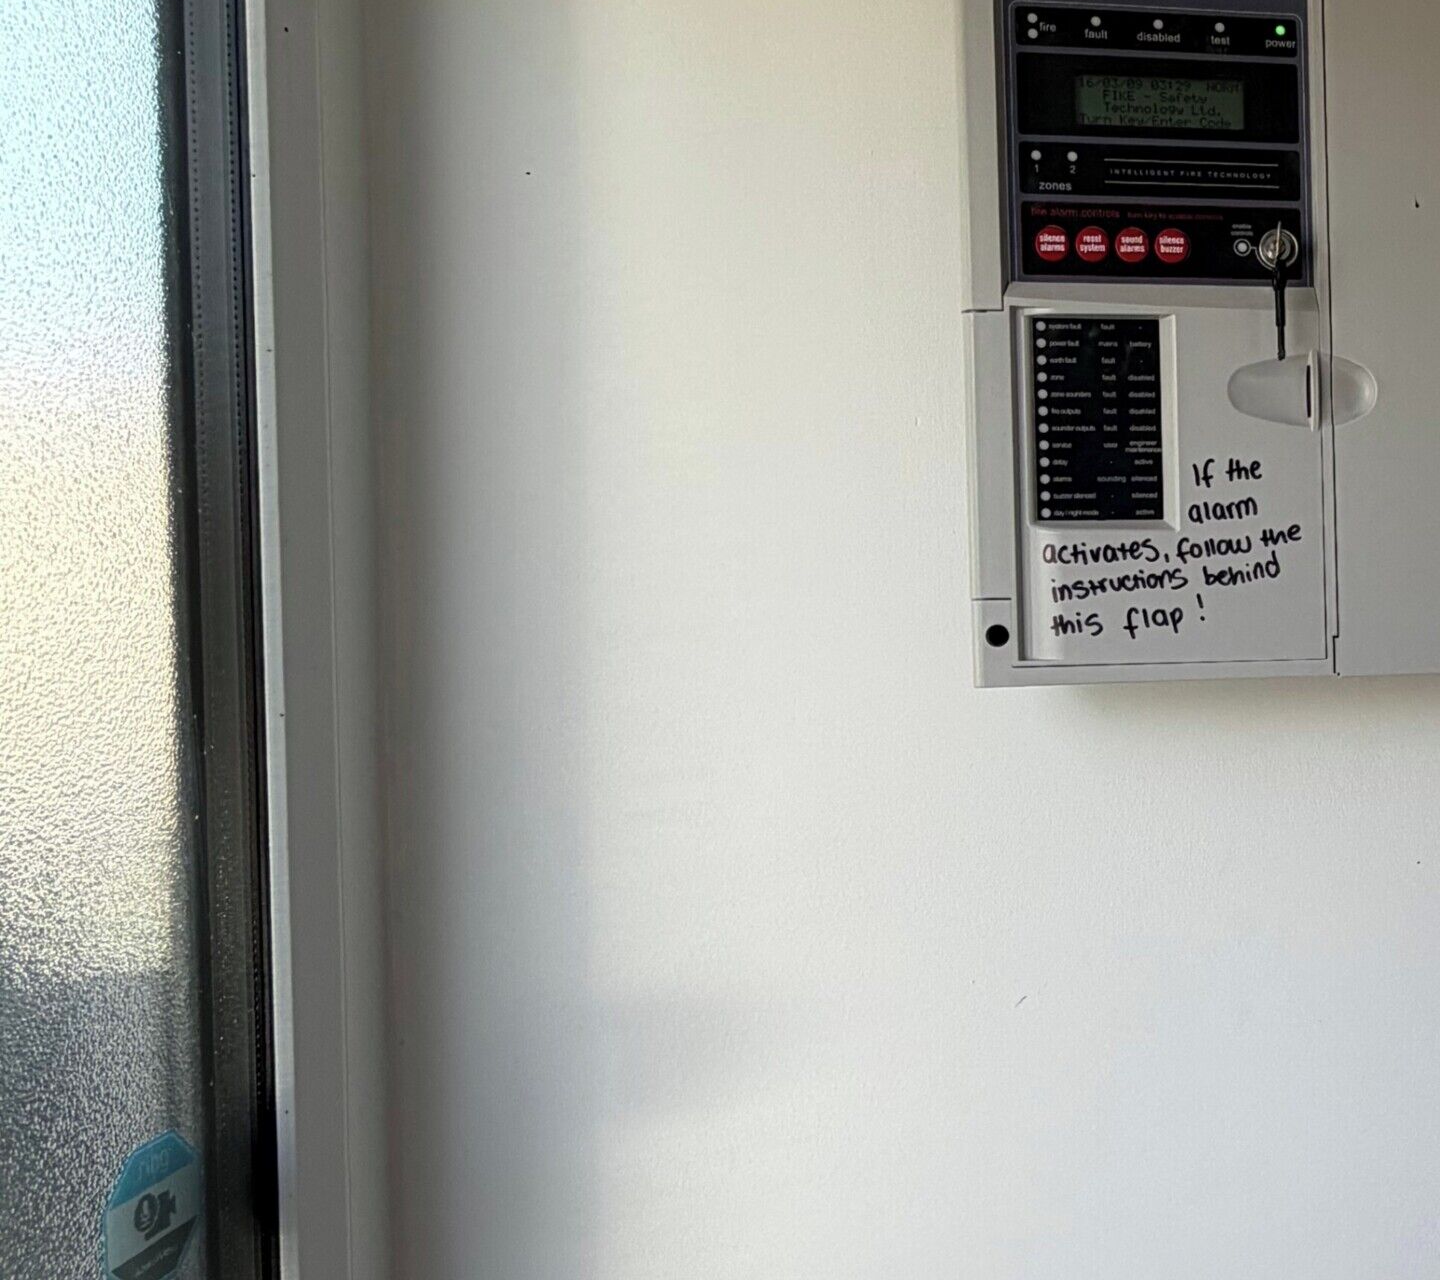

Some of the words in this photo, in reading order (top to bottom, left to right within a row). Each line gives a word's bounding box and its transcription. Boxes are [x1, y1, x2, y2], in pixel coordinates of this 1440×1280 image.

[1039, 22, 1056, 32] fire
[1085, 29, 1108, 40] fault
[1136, 32, 1180, 43] disabled
[1210, 35, 1230, 45] test
[1265, 39, 1296, 49] power
[1103, 90, 1136, 101] FIKE
[1160, 92, 1208, 104] Safety
[1104, 102, 1184, 116] Technology
[1191, 105, 1221, 117] Ltd.
[1199, 118, 1232, 129] Code
[1034, 164, 1039, 173] 1
[1069, 165, 1076, 174] 2
[1110, 168, 1175, 177] INTELLIGENT
[1208, 171, 1271, 179] TECHNOLOGY
[1039, 181, 1072, 191] zones
[1039, 234, 1065, 243] silence
[1083, 235, 1101, 243] reset
[1121, 235, 1143, 244] sound
[1159, 236, 1184, 245] silence
[1040, 242, 1065, 252] alarms
[1080, 243, 1105, 253] system
[1120, 243, 1145, 253] alarms
[1160, 244, 1184, 254] buzzer
[1193, 458, 1215, 488] If
[1225, 458, 1262, 481] the
[1188, 497, 1258, 524] alarm
[1043, 539, 1170, 565] activates,
[1176, 535, 1251, 564] follow
[1260, 524, 1302, 548] the
[1051, 568, 1189, 603] instructions
[1203, 550, 1281, 586] behind
[1050, 612, 1104, 637] this
[1123, 606, 1184, 639] flap
